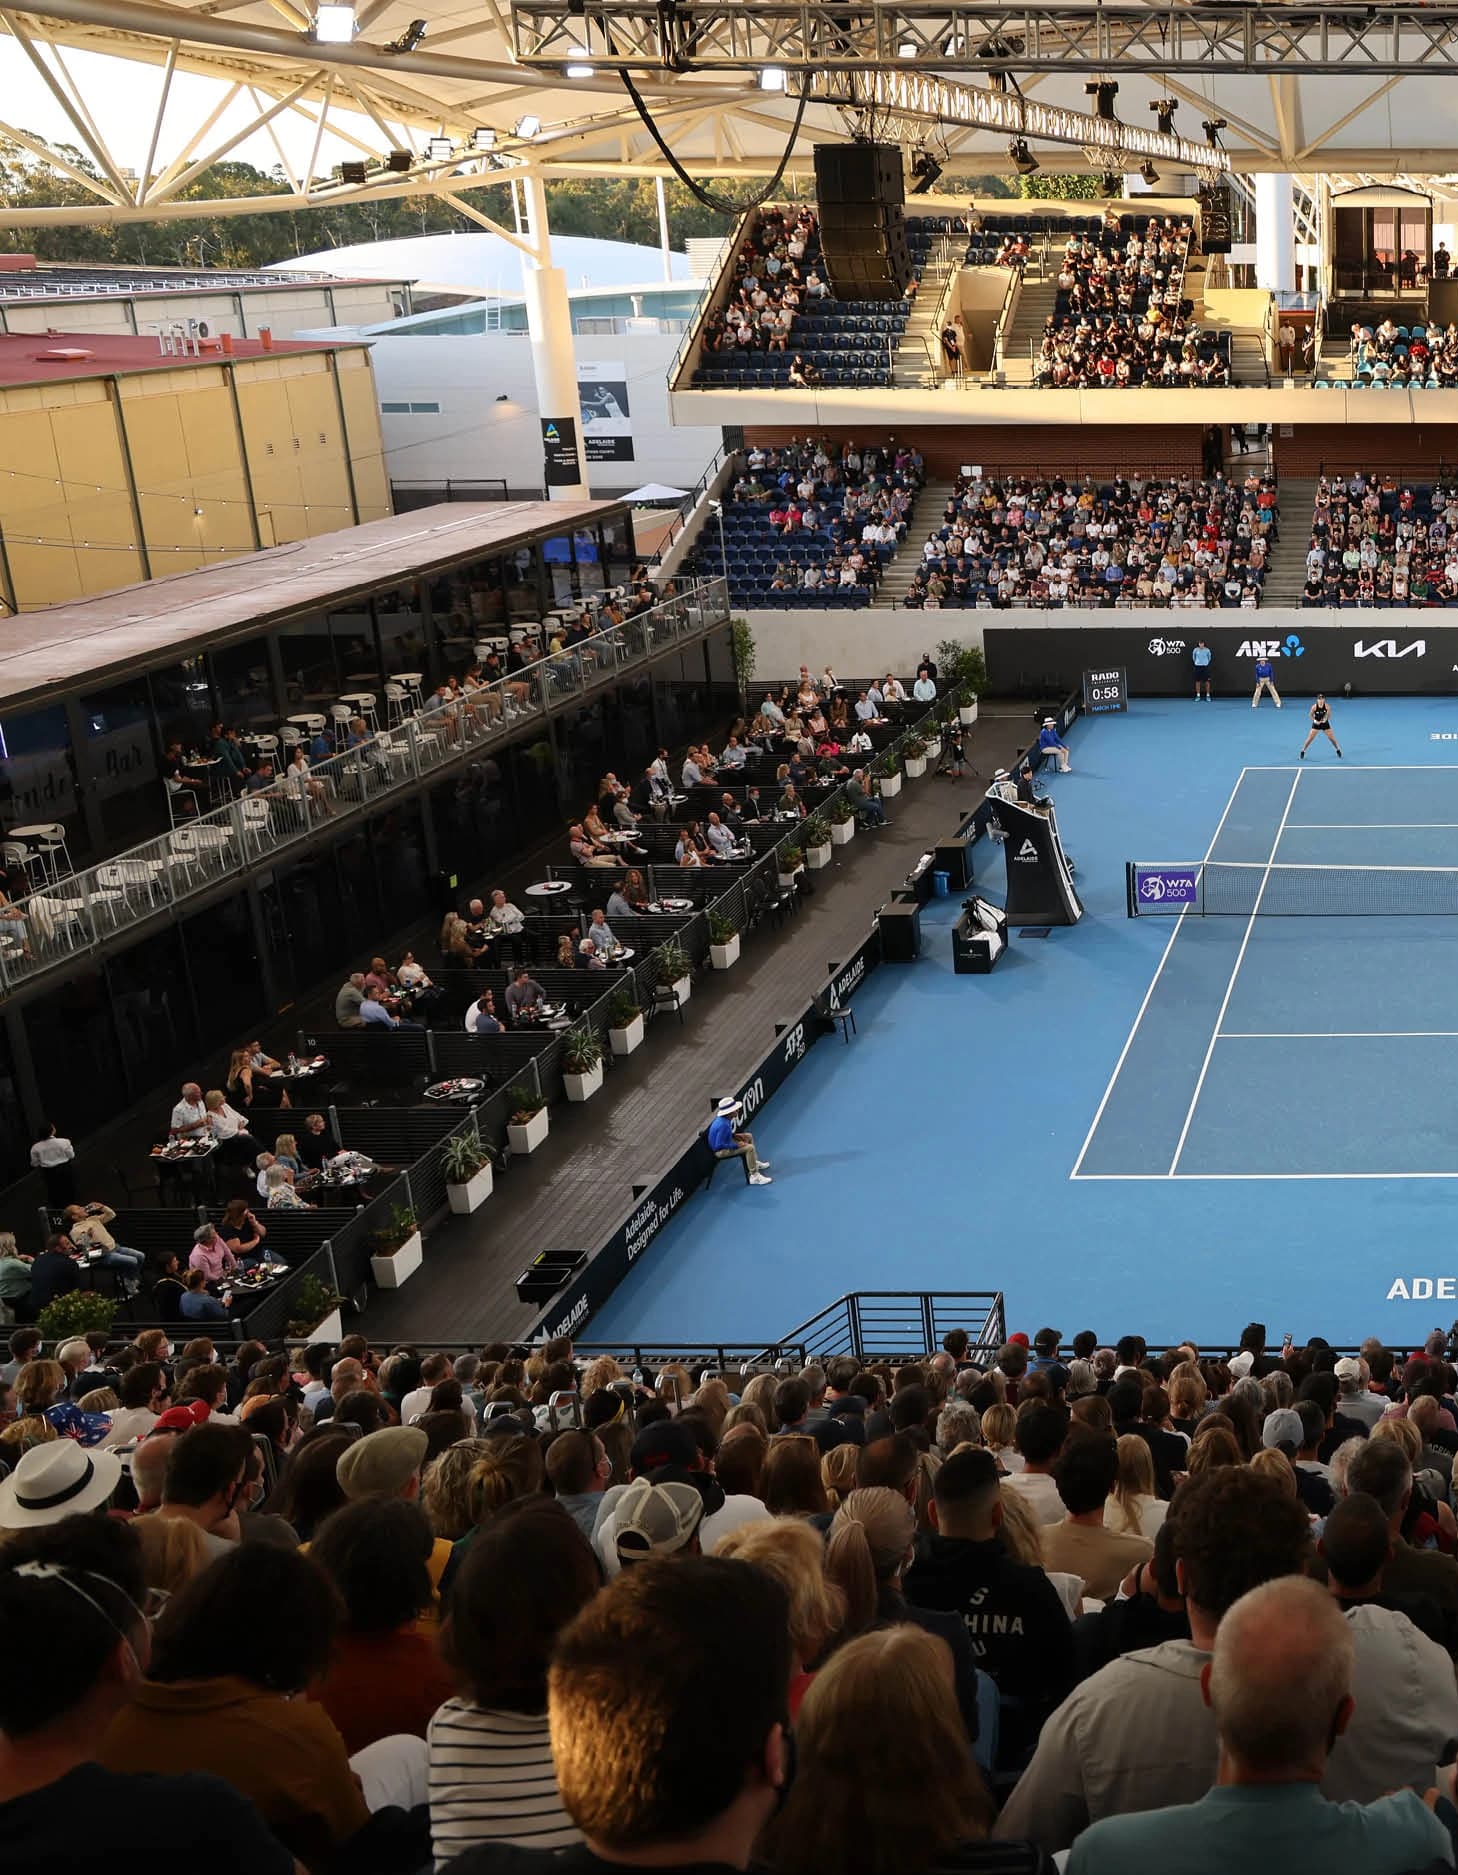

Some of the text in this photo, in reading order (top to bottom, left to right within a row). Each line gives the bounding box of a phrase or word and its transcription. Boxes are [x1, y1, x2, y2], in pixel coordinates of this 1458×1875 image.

[1166, 640, 1186, 648] WTA
[1235, 640, 1281, 657] ANZ
[1354, 640, 1426, 658] KIA
[1091, 671, 1119, 681] RADO
[1092, 686, 1119, 700] 0:58
[1166, 879, 1193, 888] WTA
[1166, 888, 1187, 897] 500
[838, 956, 865, 997] ADELAIDE
[785, 1023, 804, 1063] ATP
[730, 1077, 764, 1134] acron
[625, 1200, 657, 1243] Adelaide.
[627, 1186, 684, 1261] Designed for Life.
[552, 1293, 588, 1341] ADELAIDE
[963, 1613, 1025, 1637] HINA
